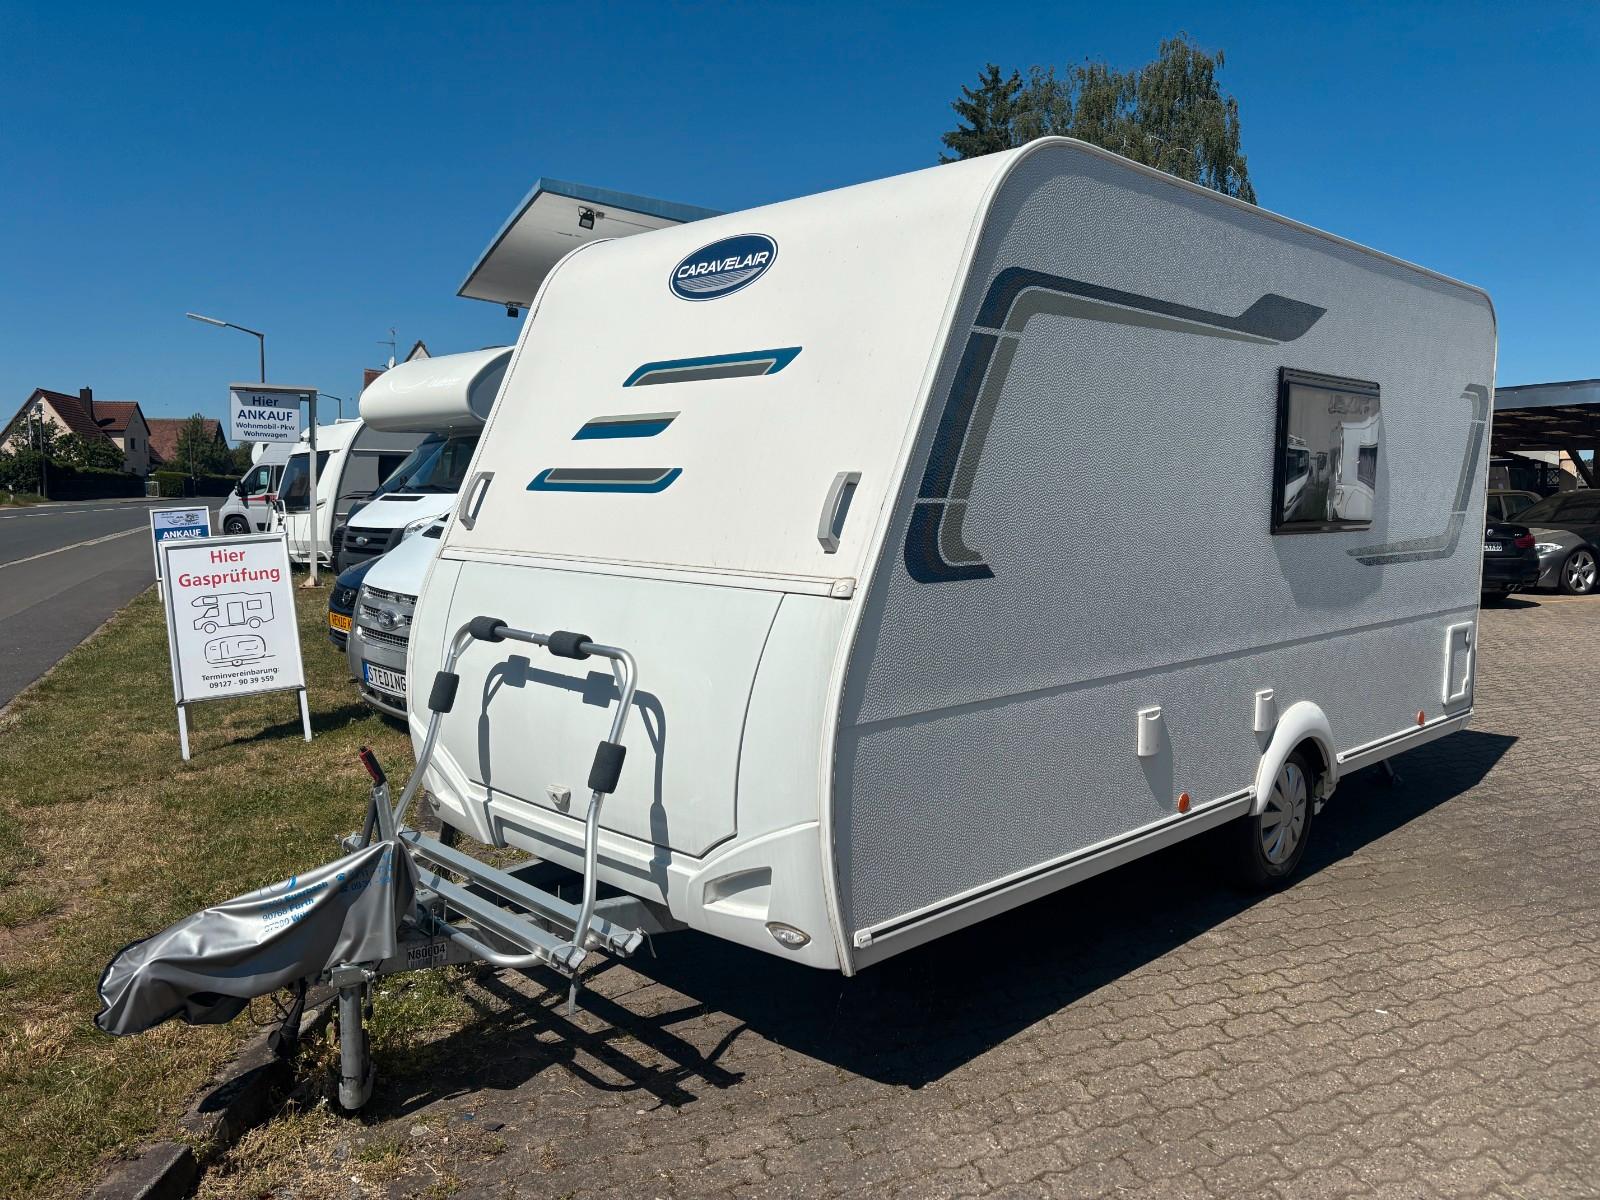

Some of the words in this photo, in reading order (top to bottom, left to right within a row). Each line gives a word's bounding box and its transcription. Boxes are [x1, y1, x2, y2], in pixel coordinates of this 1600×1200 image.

[678, 252, 769, 278] CARAVELAIR
[252, 395, 279, 407] Hier
[237, 409, 293, 422] ANKAUF
[243, 430, 288, 440] Wohnwagen
[162, 528, 202, 539] ANKAUF
[210, 549, 246, 564] Hier
[178, 567, 281, 589] Gasprüfung
[201, 667, 280, 681] Terminvereinbarung:
[368, 666, 407, 692] STEDING
[209, 680, 232, 689] 09127
[238, 678, 249, 686] 90
[260, 675, 275, 683] 559
